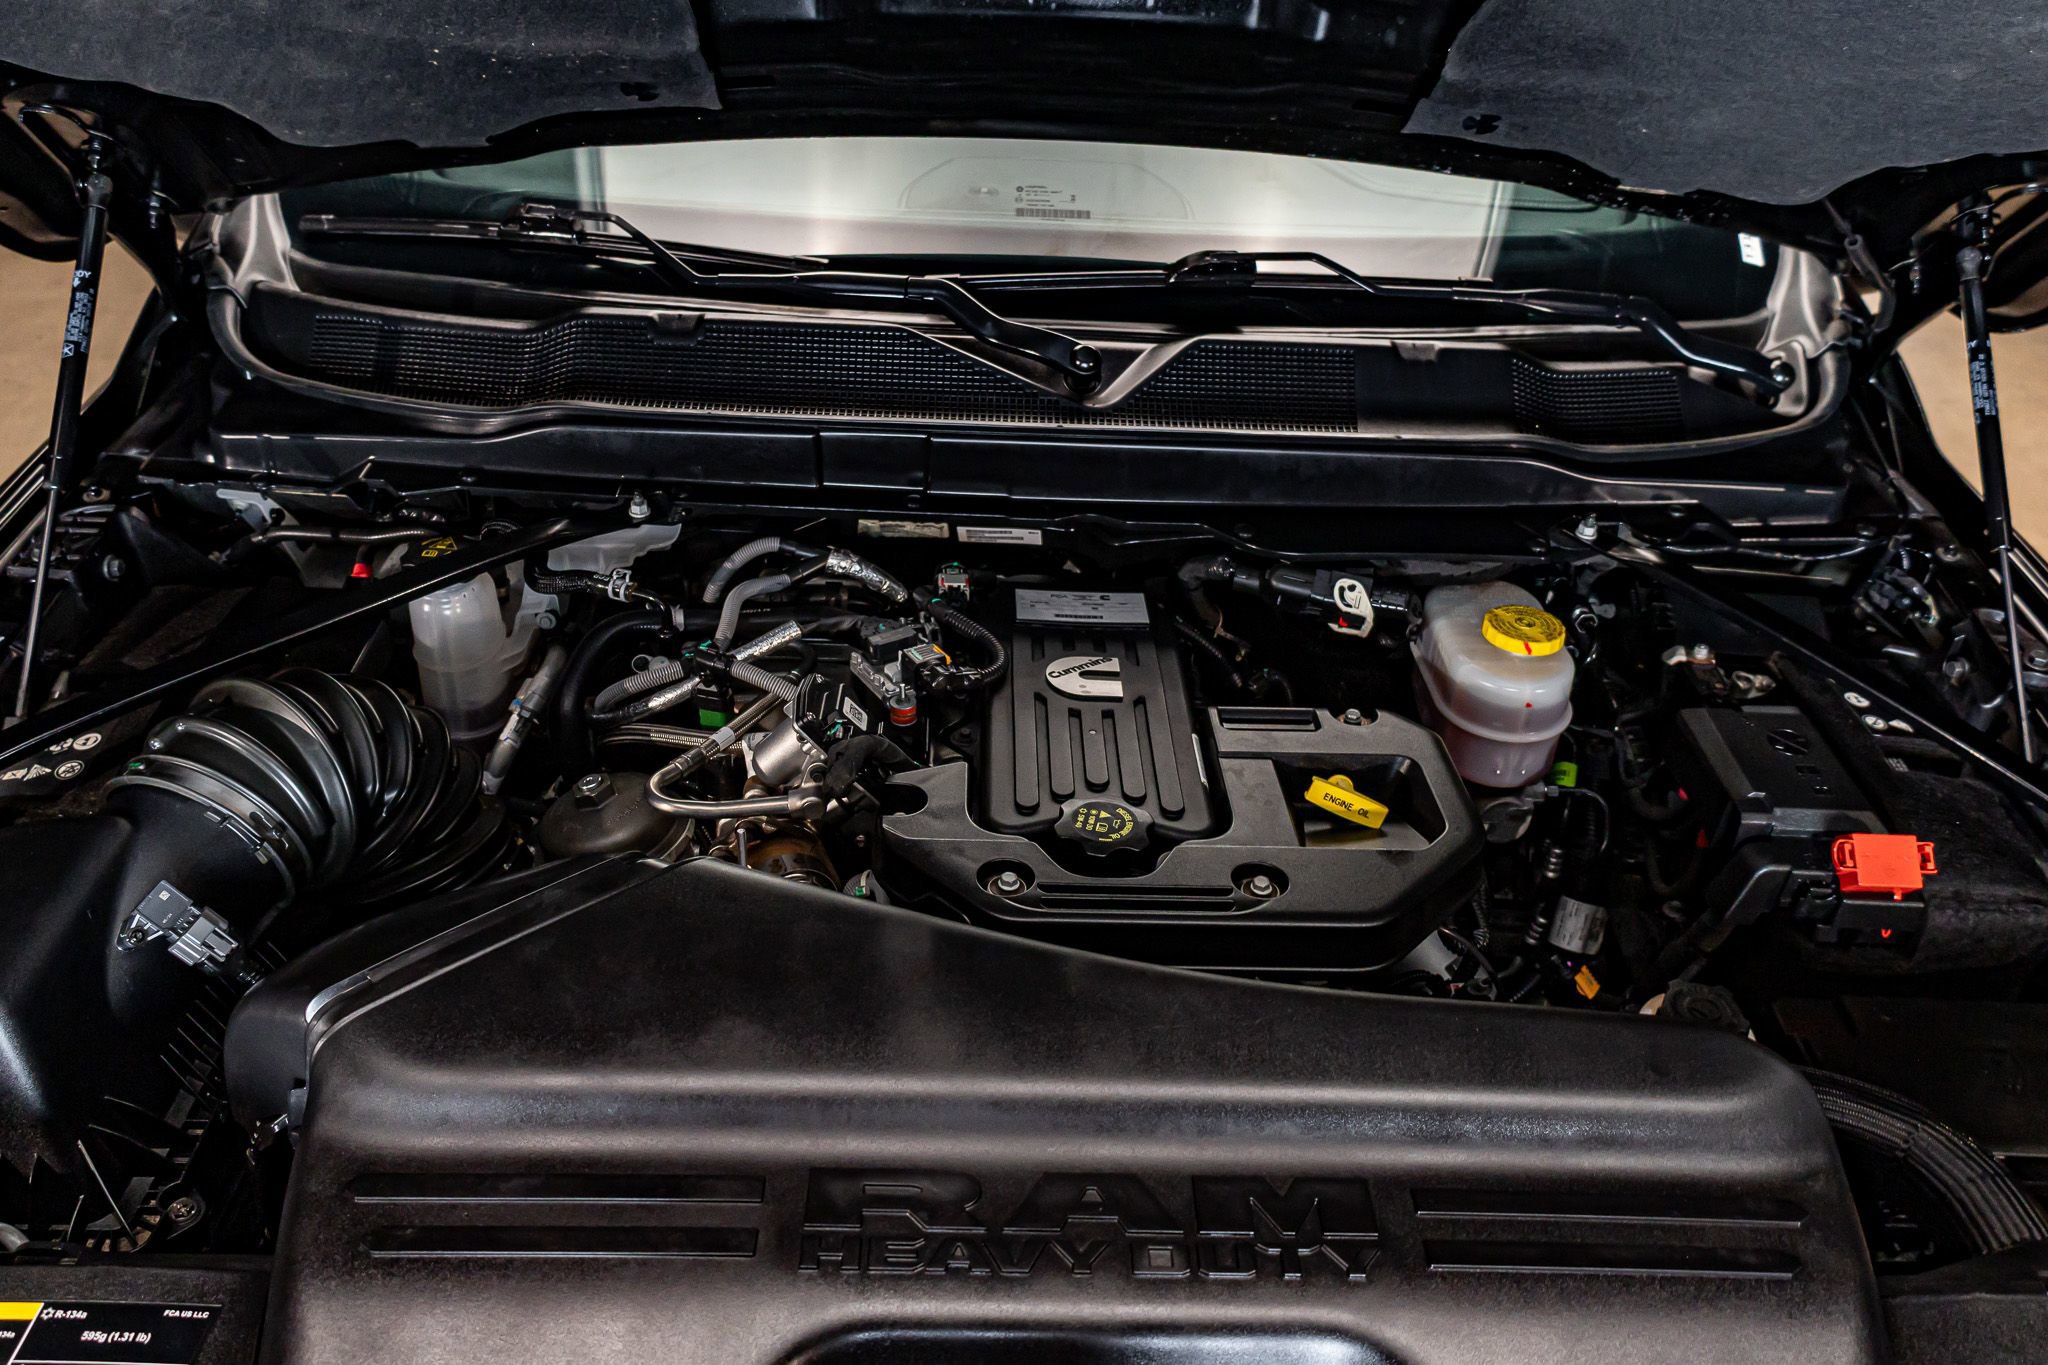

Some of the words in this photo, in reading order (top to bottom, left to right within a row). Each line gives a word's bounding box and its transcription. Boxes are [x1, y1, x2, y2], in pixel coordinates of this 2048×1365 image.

[1323, 792, 1354, 812] ENGINE
[1357, 807, 1370, 820] OIL
[803, 1168, 1380, 1236] RAM
[798, 1235, 1110, 1277] HEAVY
[1132, 1241, 1381, 1281] DUTY
[54, 1309, 88, 1320] R-134a
[163, 1309, 180, 1317] FCA
[80, 1330, 107, 1343] 595g
[107, 1331, 135, 1343] (1.31
[136, 1332, 152, 1345] lb)
